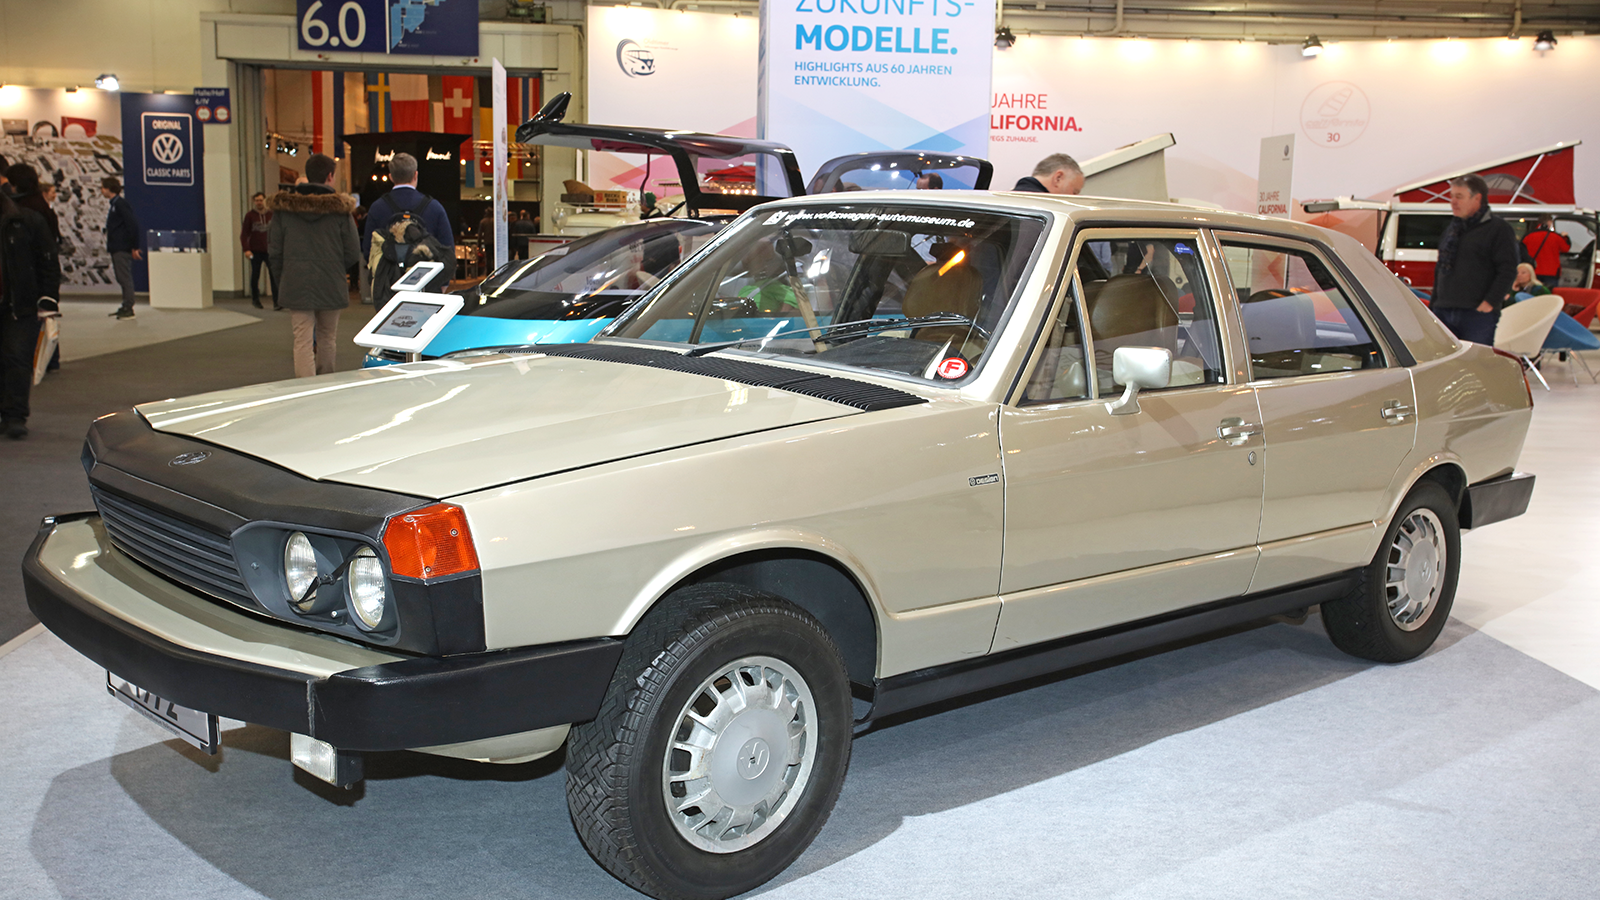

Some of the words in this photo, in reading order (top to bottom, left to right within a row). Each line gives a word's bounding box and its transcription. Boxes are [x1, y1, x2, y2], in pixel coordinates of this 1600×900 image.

[301, 0, 367, 48] 6.0
[795, 24, 958, 55] MODELLE.
[794, 61, 864, 73] HIGHLIGHTS
[865, 63, 889, 74] AUS
[890, 64, 906, 74] 60
[906, 65, 953, 75] JAHREN
[794, 75, 881, 87] ENTWICKLUNG.
[991, 93, 1048, 110] JAHRE
[152, 119, 182, 130] ORIGINAL
[1326, 132, 1341, 143] 30
[147, 167, 171, 178] CLASSIC
[172, 168, 191, 178] PARTS
[1259, 192, 1265, 202] 30
[1265, 191, 1280, 202] JAHRE
[1258, 204, 1287, 215] CALIFORNIA.
[944, 361, 961, 374] F
